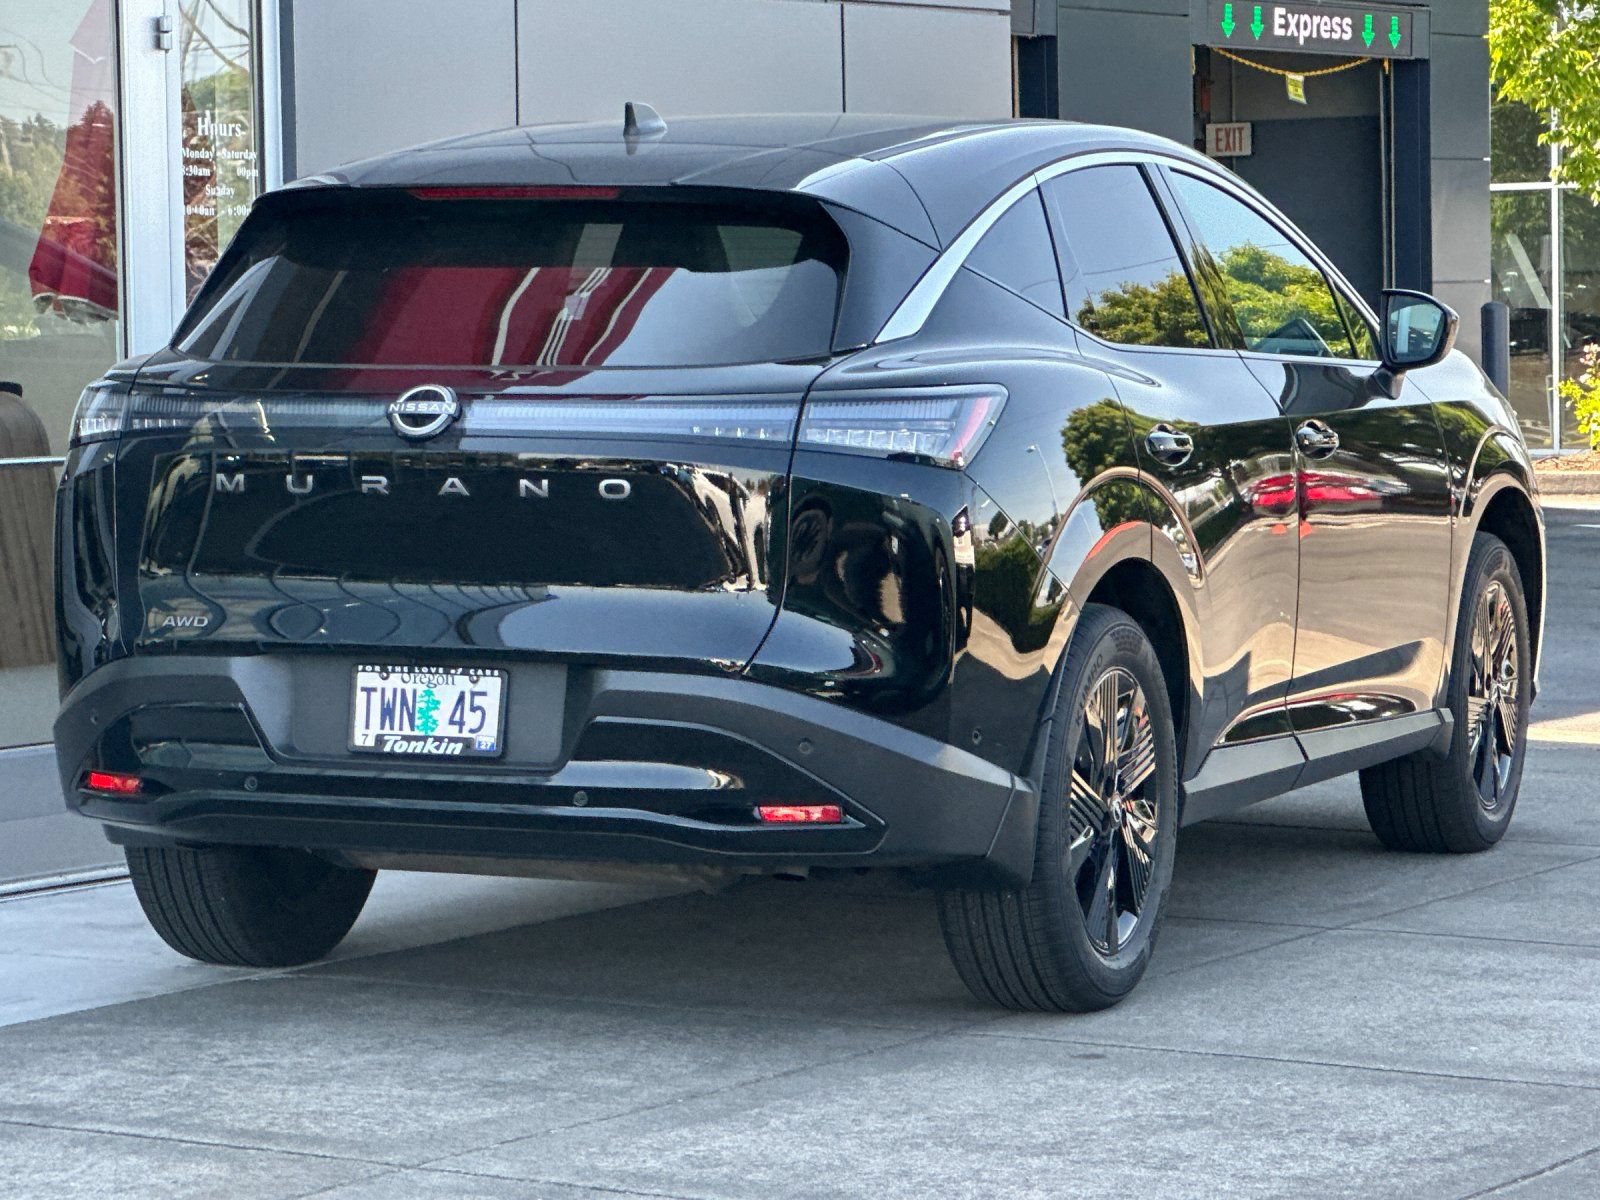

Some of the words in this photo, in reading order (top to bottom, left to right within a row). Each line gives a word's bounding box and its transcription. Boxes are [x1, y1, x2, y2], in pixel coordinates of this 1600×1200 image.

[1273, 7, 1353, 46] Express
[197, 116, 242, 137] Hours
[1215, 126, 1245, 153] EXIT
[222, 149, 257, 162] Saturday
[205, 184, 236, 198] Sunday
[389, 403, 453, 412] NISSAN
[215, 473, 632, 500] MURANO
[162, 615, 209, 627] AWD
[357, 664, 381, 672] FOR
[387, 665, 409, 673] THE
[414, 666, 444, 674] LOVE
[469, 668, 500, 676] CARS
[401, 672, 457, 689] Oregon
[360, 686, 417, 732] TWN
[448, 689, 488, 734] 45
[361, 733, 369, 745] 7
[383, 735, 464, 755] Tonkin
